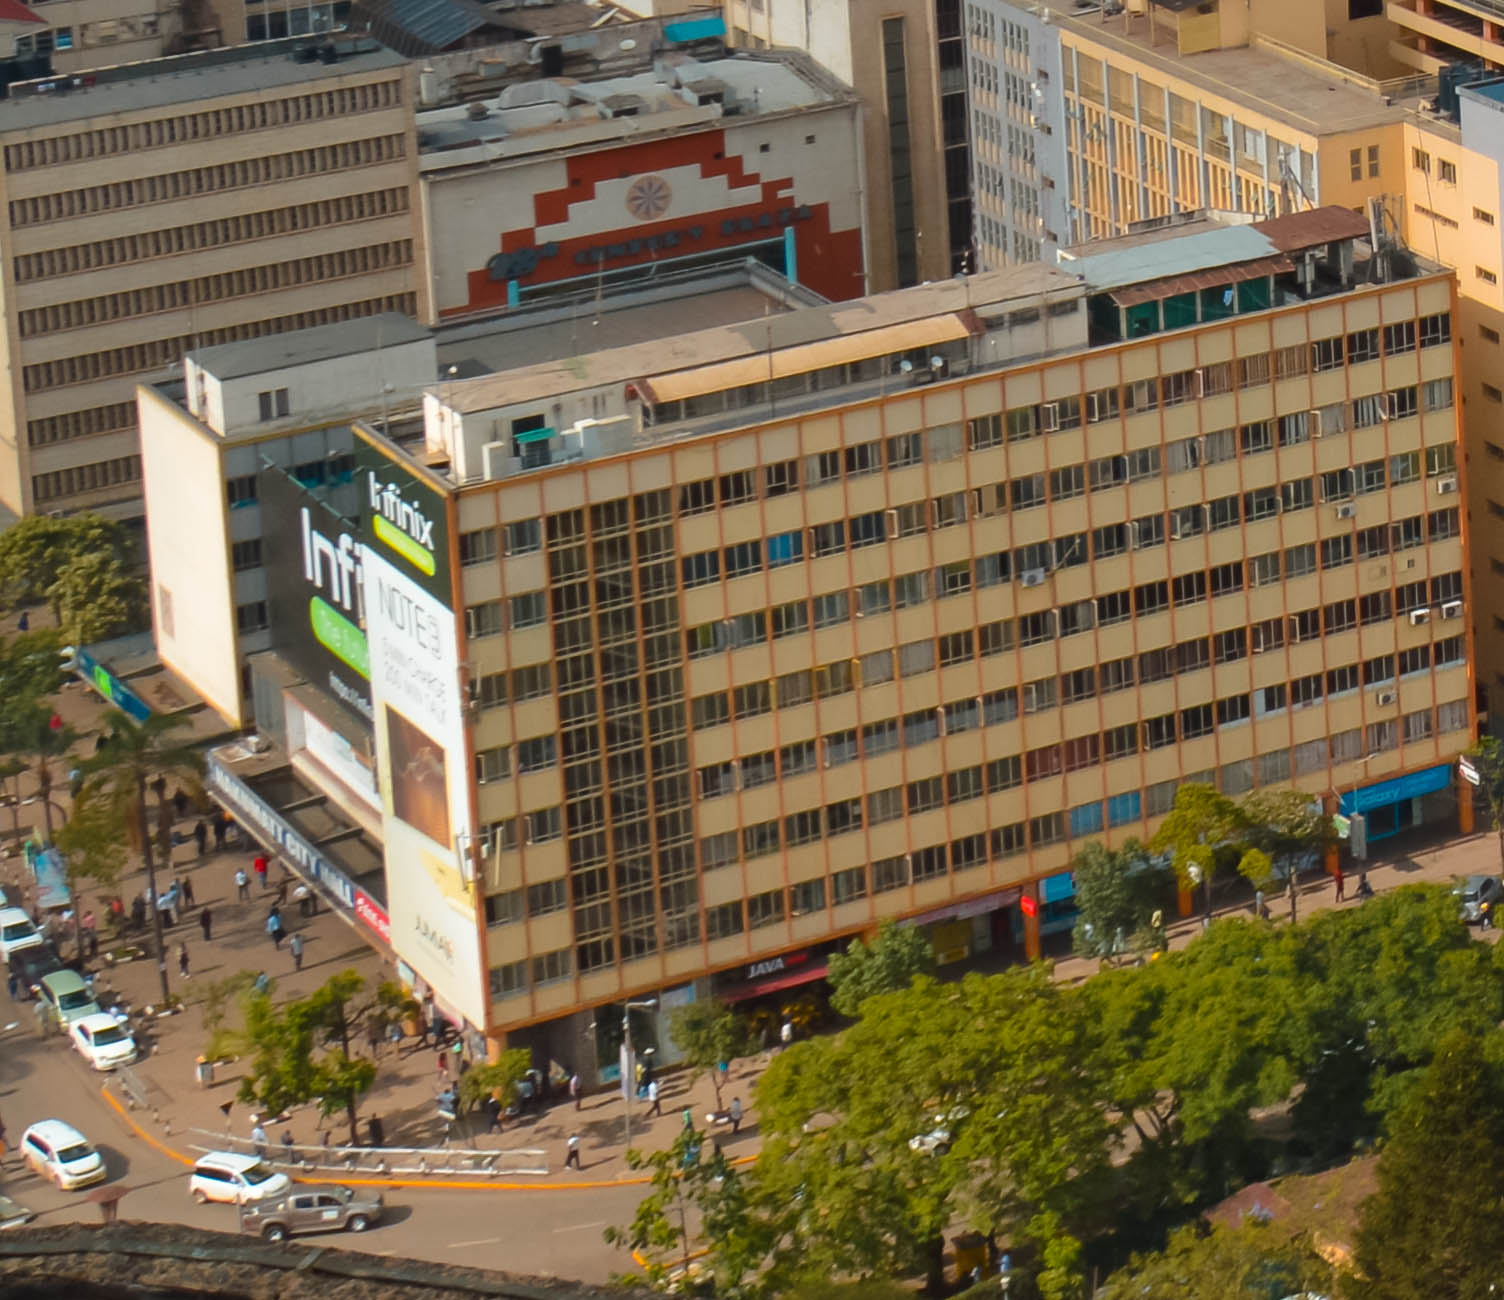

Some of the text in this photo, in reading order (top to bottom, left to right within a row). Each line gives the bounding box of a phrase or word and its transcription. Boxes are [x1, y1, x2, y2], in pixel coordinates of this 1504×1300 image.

[369, 471, 434, 551] Infinix
[285, 830, 319, 877] CITY
[746, 956, 785, 980] JAVA
